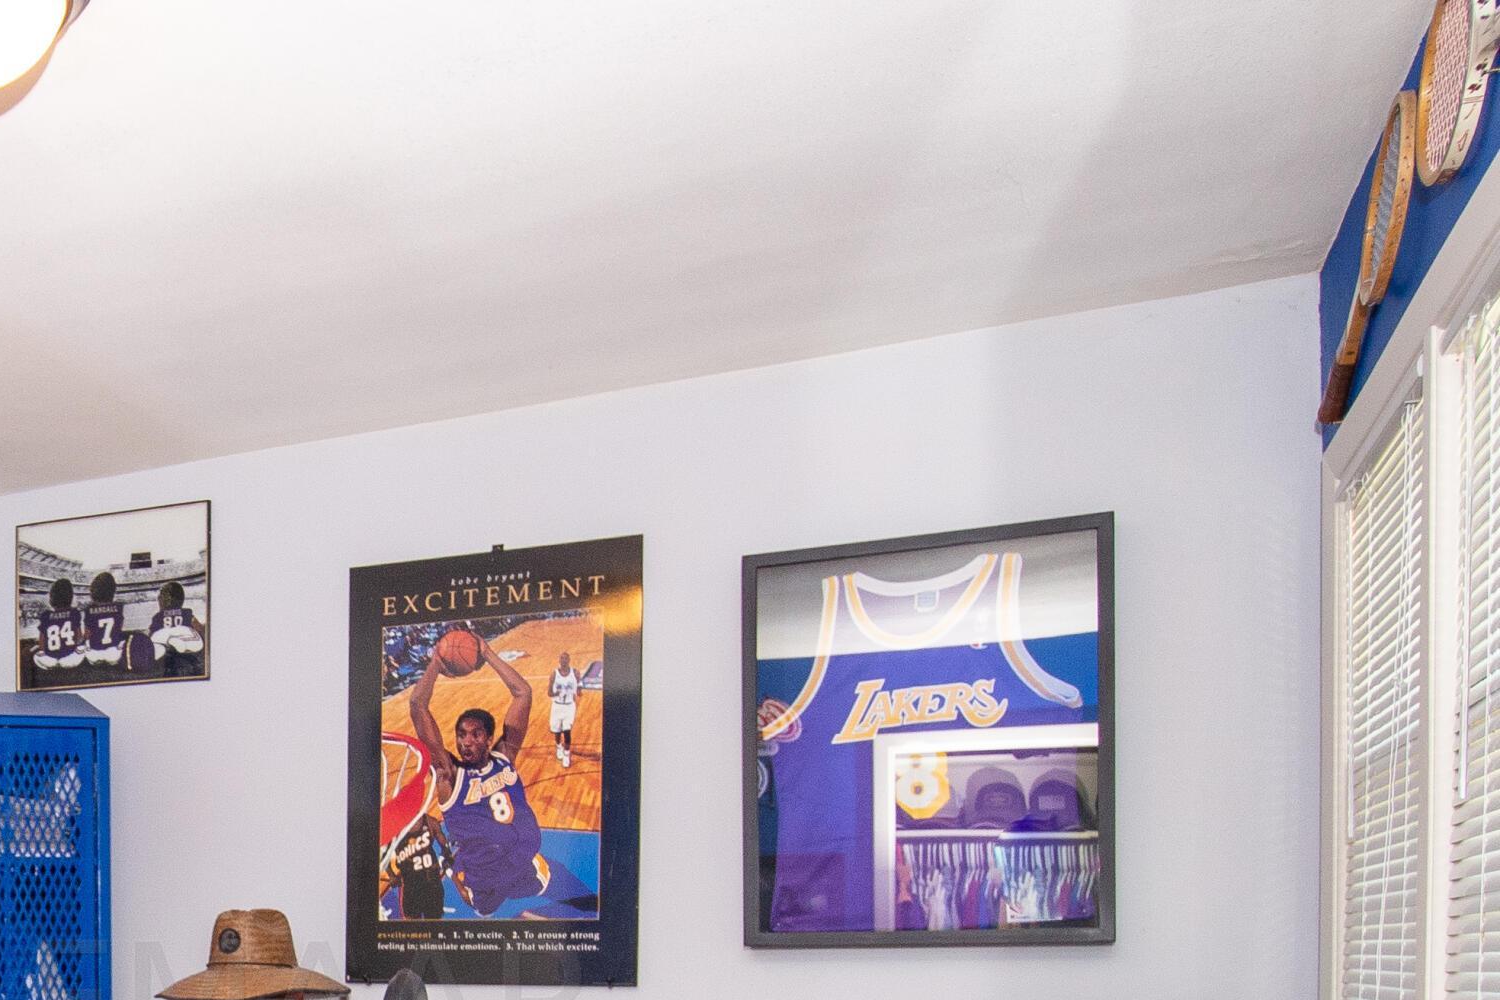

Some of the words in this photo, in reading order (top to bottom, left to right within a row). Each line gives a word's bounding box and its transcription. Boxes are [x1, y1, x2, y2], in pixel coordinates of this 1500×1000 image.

[450, 574, 479, 587] kobe
[486, 570, 531, 584] bryant
[382, 575, 605, 617] EXCITEMENT
[47, 620, 75, 651] 84
[98, 617, 115, 645] 7
[162, 615, 184, 628] 80
[831, 678, 1009, 745] LAKERS
[896, 750, 951, 820] 8
[489, 791, 515, 824] 8
[412, 853, 433, 871] 20
[377, 942, 405, 952] feeling
[420, 942, 459, 951] stimulate
[460, 942, 502, 951] emotions.
[506, 942, 514, 951] 3.
[516, 942, 536, 951] That
[538, 942, 565, 951] which
[566, 943, 600, 951] excites.
[453, 931, 461, 940] 1.
[464, 931, 474, 940] To
[476, 931, 506, 940] excite.
[512, 931, 520, 940] 2.
[524, 930, 534, 940] To
[537, 932, 567, 940] arouse
[570, 931, 600, 941] strong
